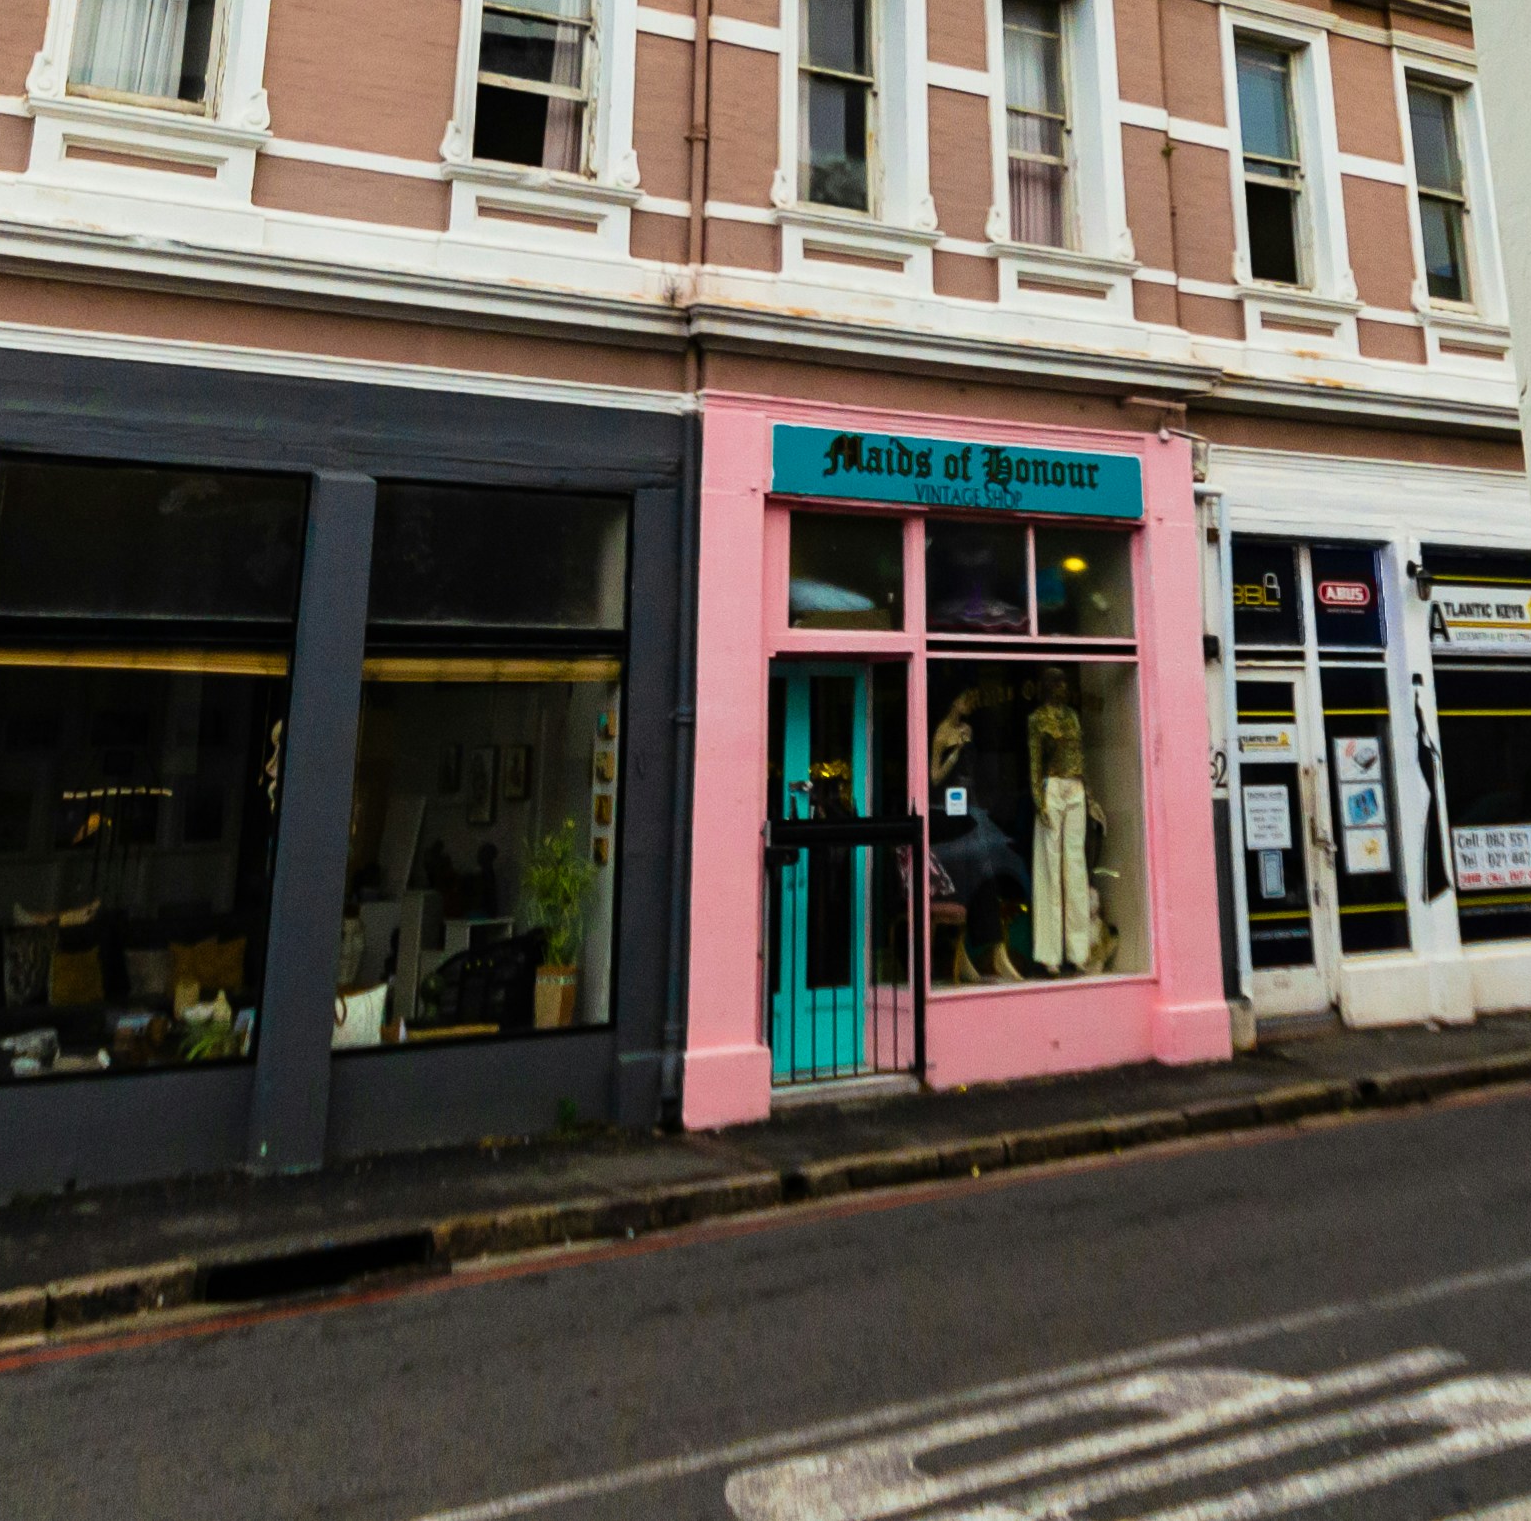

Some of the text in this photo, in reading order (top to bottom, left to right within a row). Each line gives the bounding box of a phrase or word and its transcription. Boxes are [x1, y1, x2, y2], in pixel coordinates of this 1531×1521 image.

[823, 434, 1100, 497] Maids of Honour
[913, 483, 1023, 509] VINTAGE SHOP
[1325, 586, 1365, 602] ABUS
[1429, 600, 1525, 642] ATLANTIC KEYS
